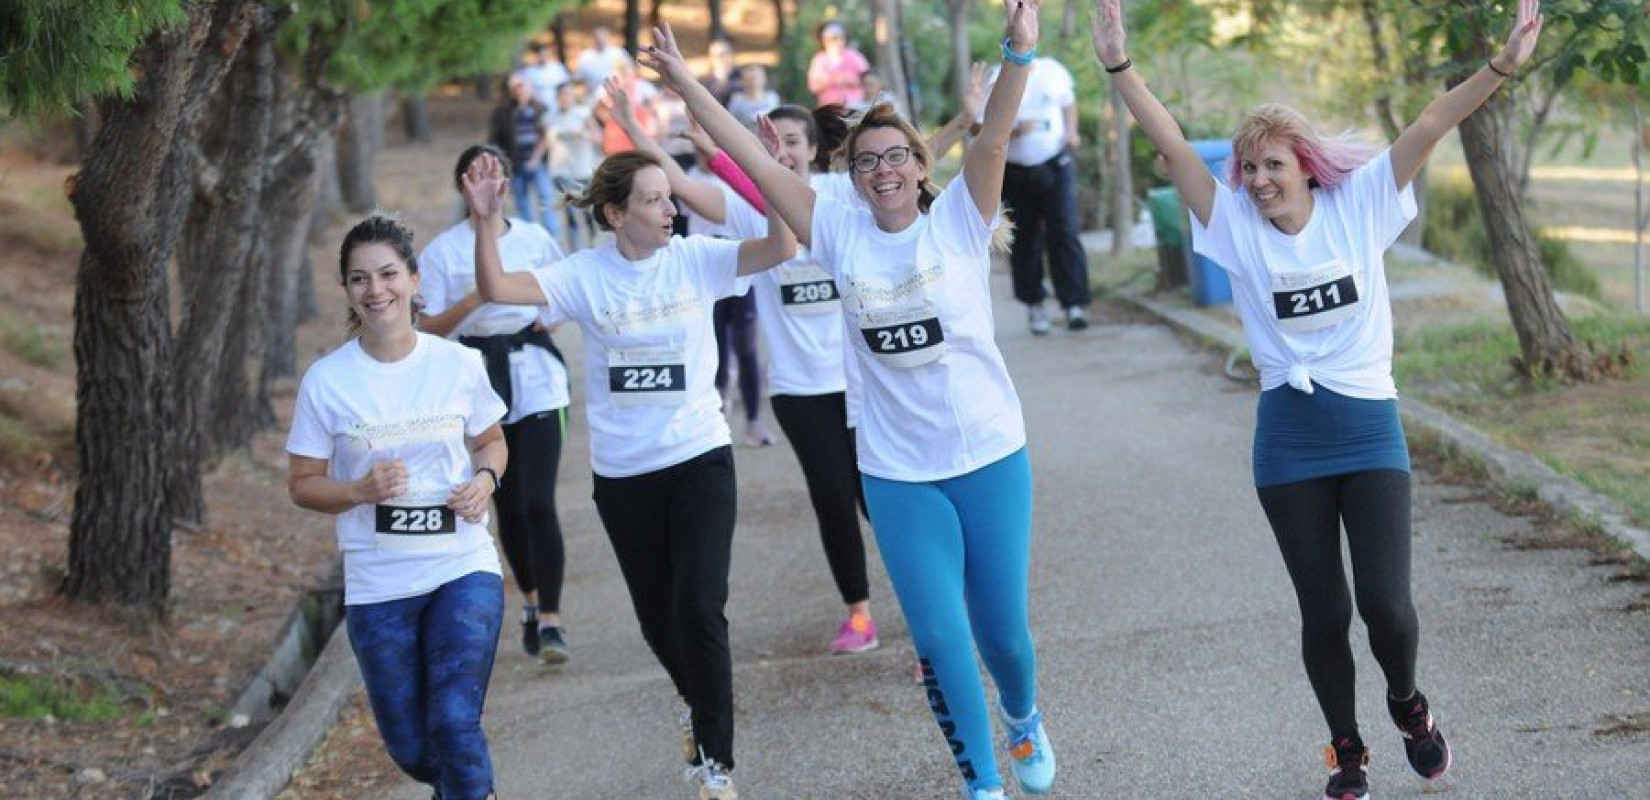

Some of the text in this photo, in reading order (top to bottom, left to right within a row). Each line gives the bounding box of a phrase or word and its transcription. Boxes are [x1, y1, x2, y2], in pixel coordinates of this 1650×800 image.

[792, 282, 833, 302] 209
[1290, 283, 1341, 313] 211
[877, 324, 929, 351] 219
[623, 367, 673, 390] 224
[391, 509, 442, 532] 228
